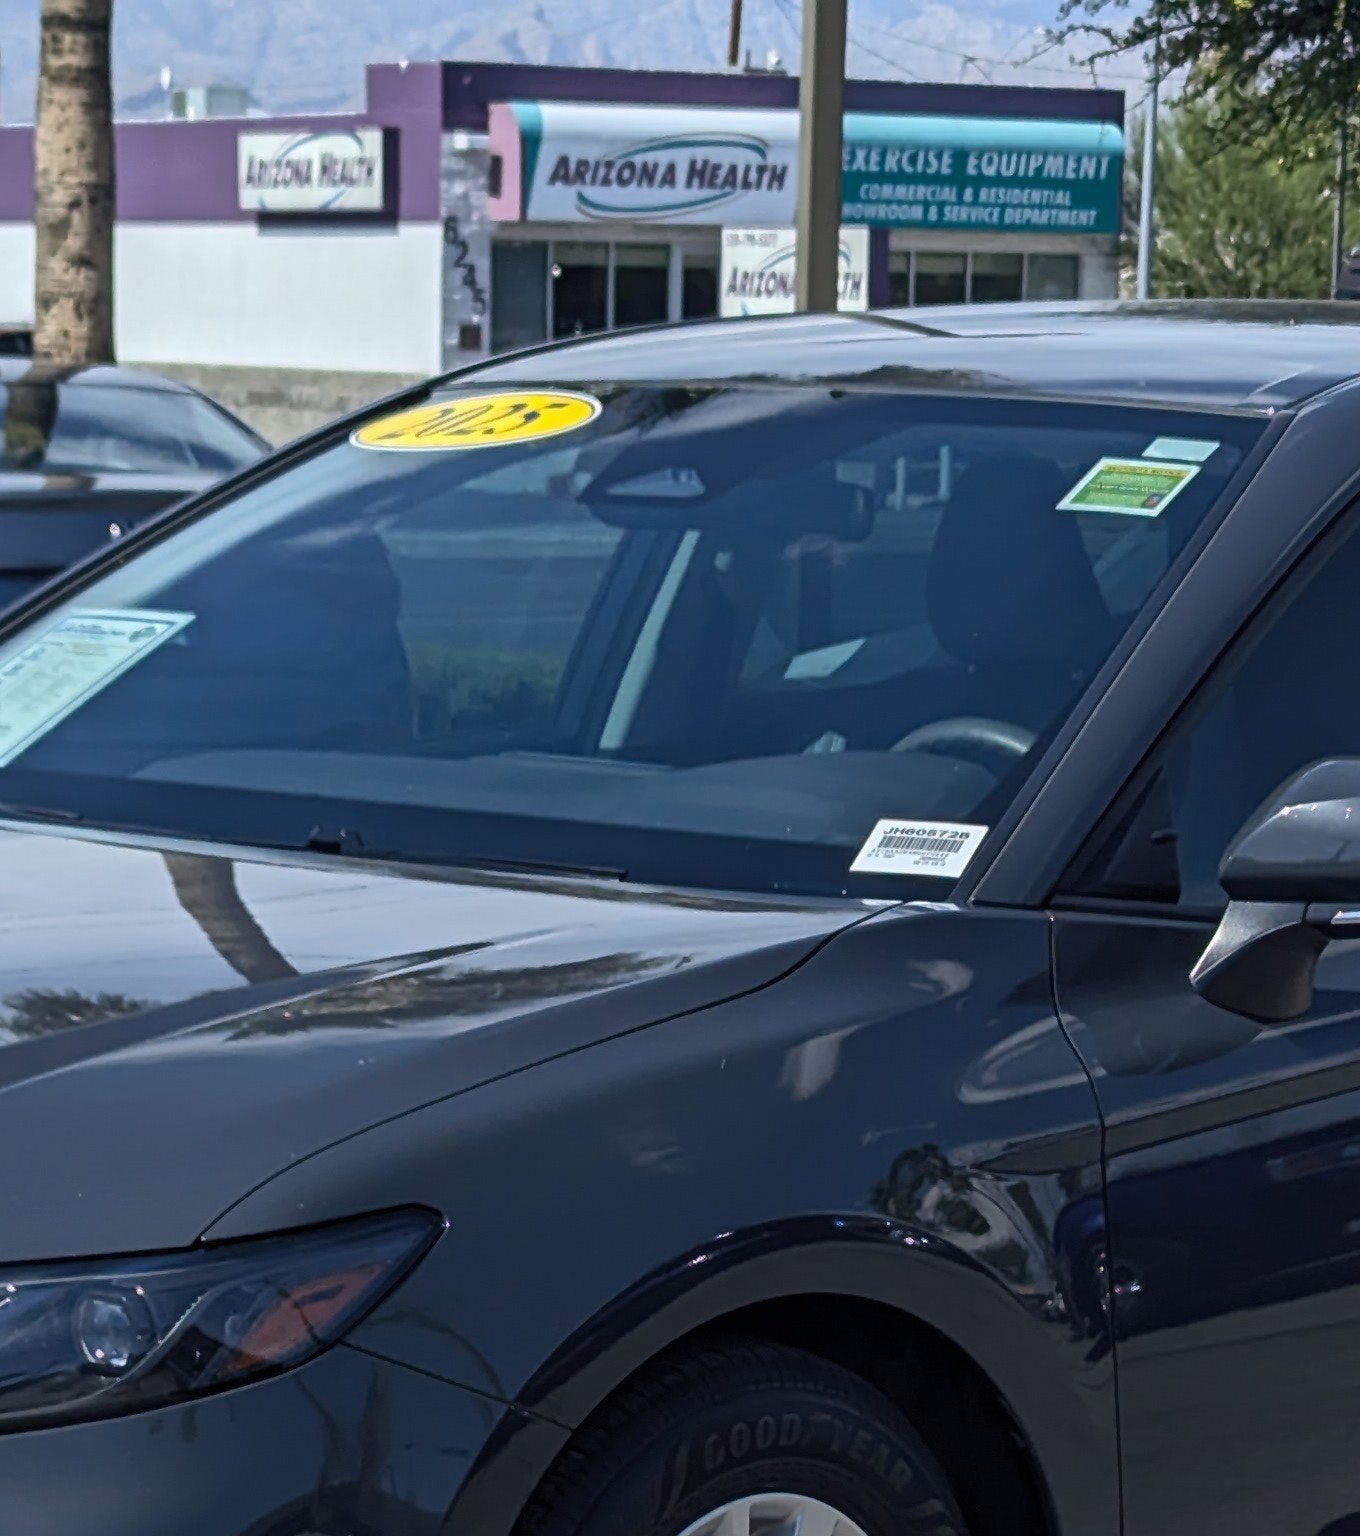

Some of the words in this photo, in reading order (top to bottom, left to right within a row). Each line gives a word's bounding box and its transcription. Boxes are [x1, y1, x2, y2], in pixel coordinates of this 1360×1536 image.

[246, 154, 313, 188] ARIZONA
[547, 154, 677, 189] ARIZONA
[685, 158, 788, 191] HEALTH
[842, 146, 952, 175] EXERCISE
[966, 150, 1111, 180] EQUIPMENT
[860, 182, 957, 203] COMMERCIAL
[978, 186, 1072, 206] RESIDENTIAL
[842, 202, 924, 221] HOWROOM
[943, 204, 1001, 225] SERVICE
[1003, 207, 1097, 226] DEPARTMENT
[725, 265, 796, 299] ARIZON
[372, 402, 571, 441] 2025
